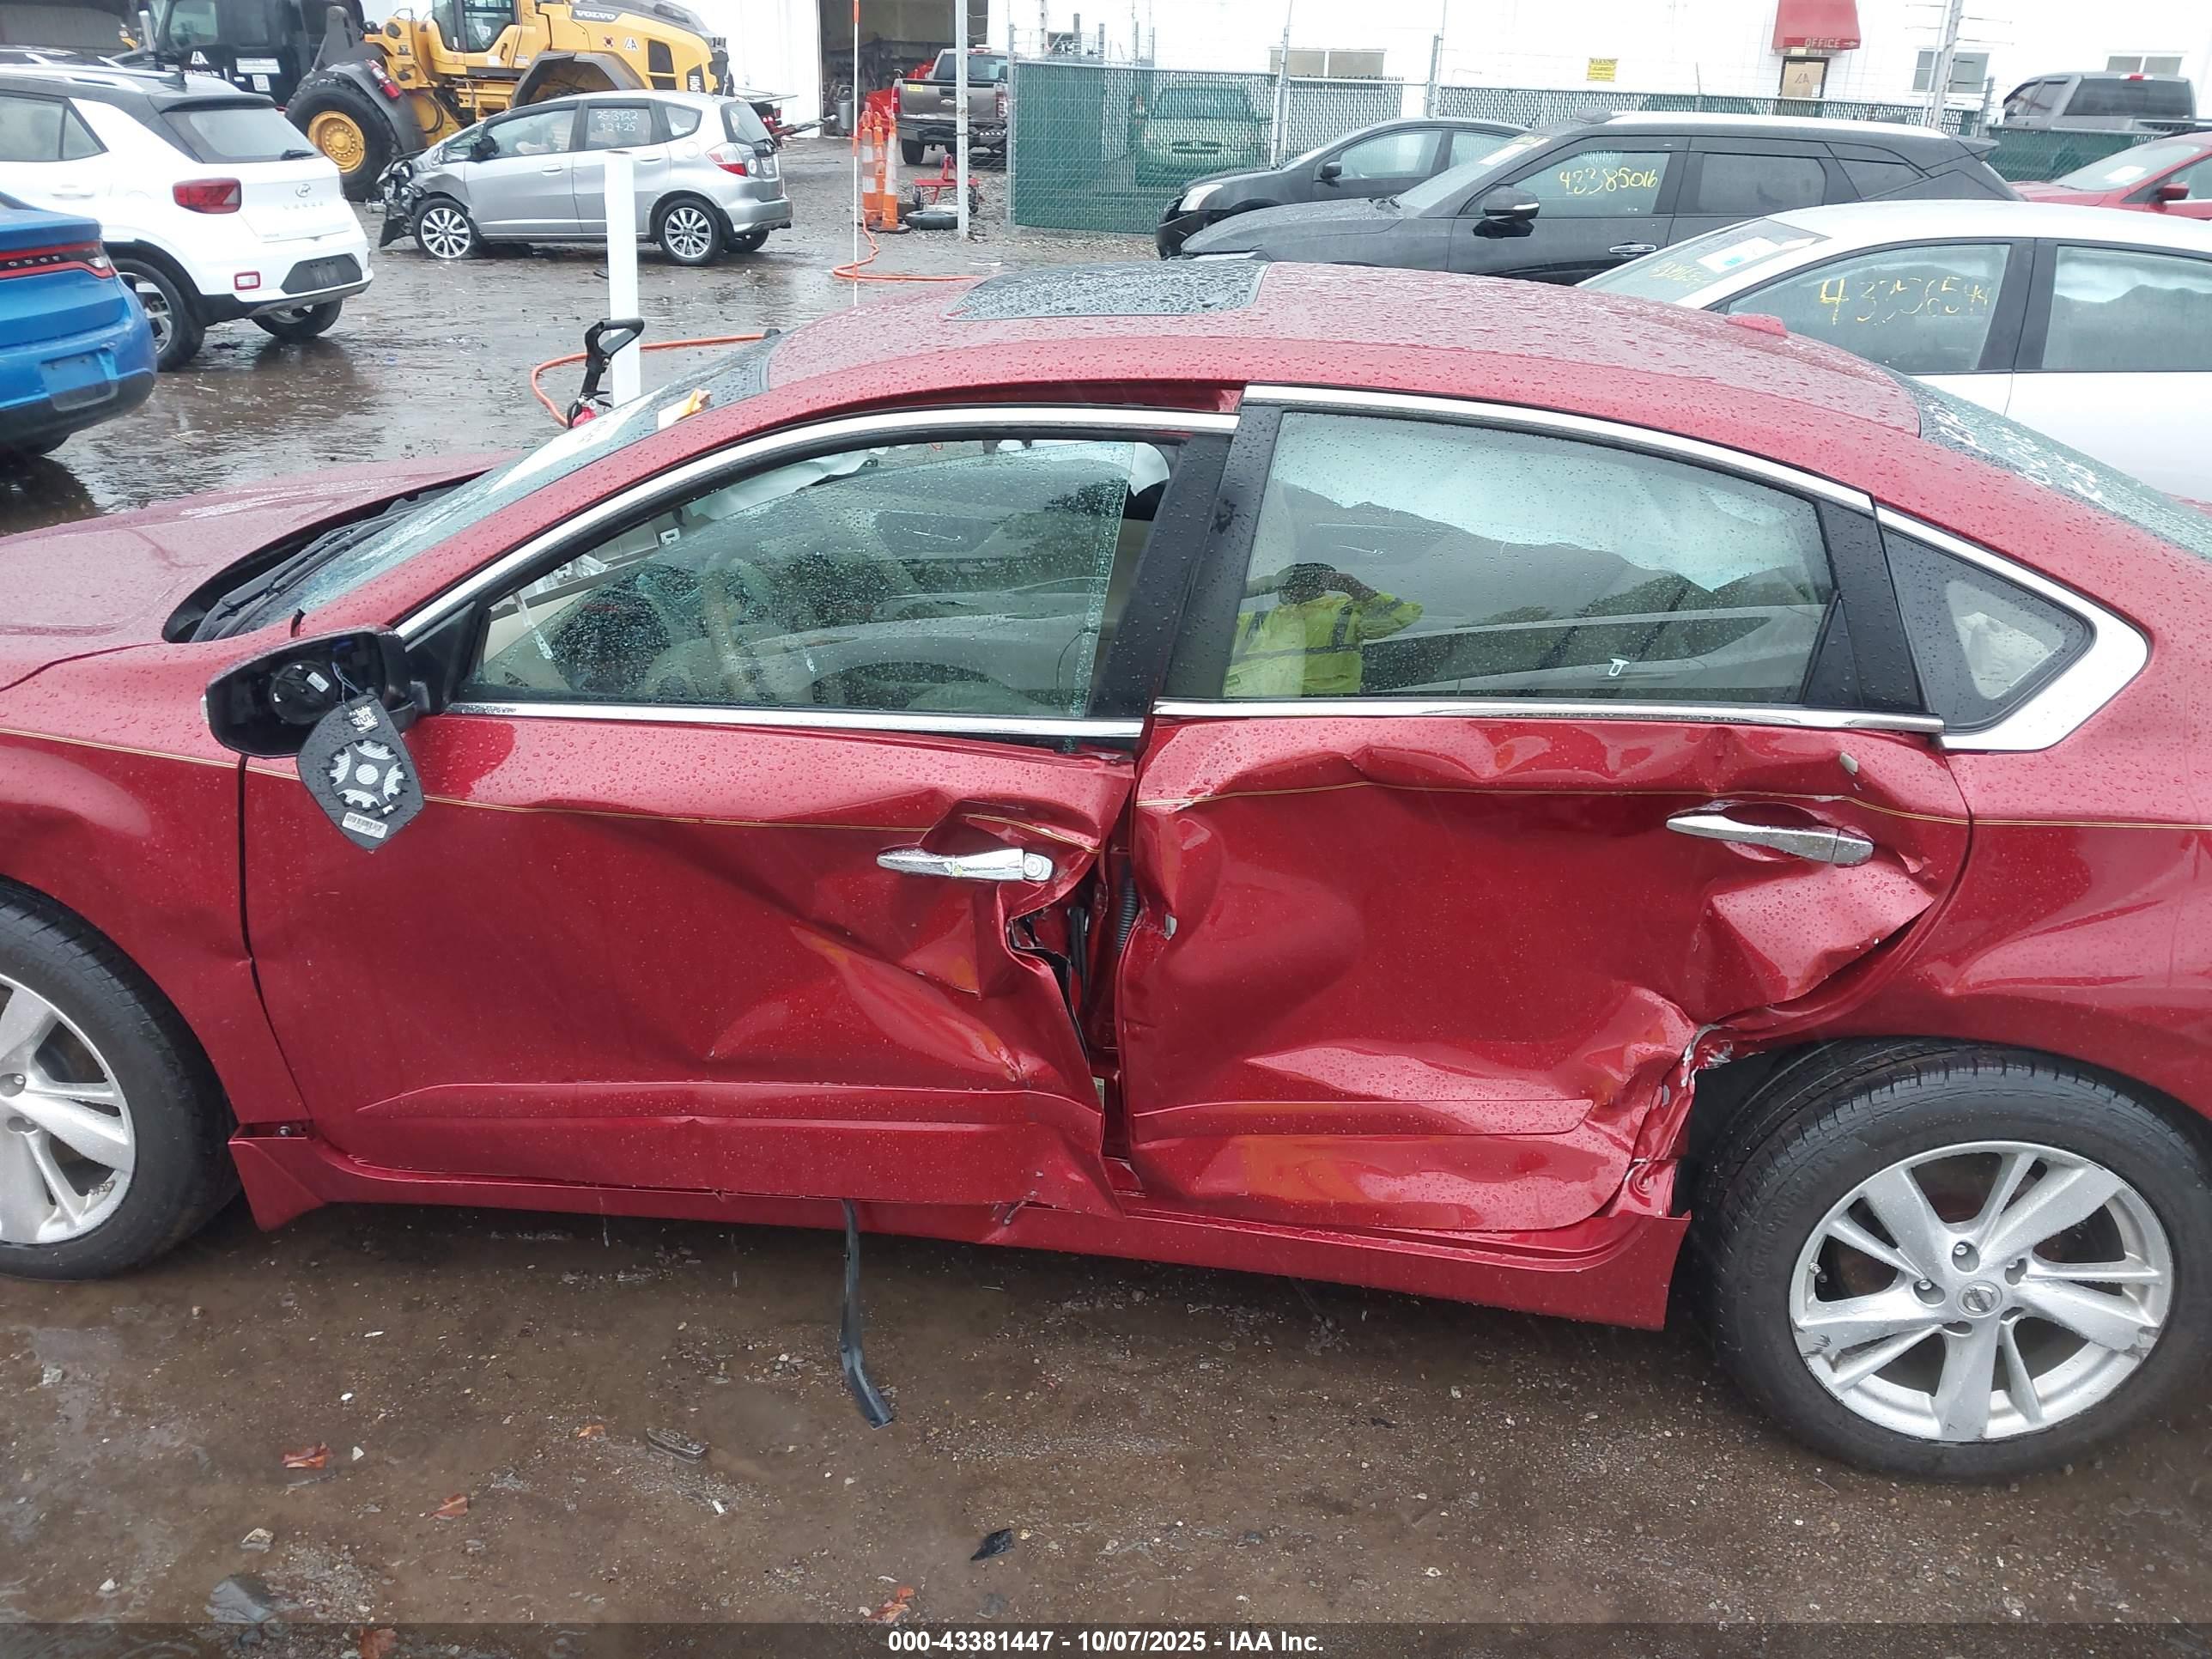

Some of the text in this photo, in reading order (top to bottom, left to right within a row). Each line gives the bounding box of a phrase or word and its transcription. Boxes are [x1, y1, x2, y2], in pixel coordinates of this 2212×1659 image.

[574, 9, 617, 21] VOLVO
[1804, 38, 1842, 49] OFFICE
[7, 255, 60, 267] ODGE
